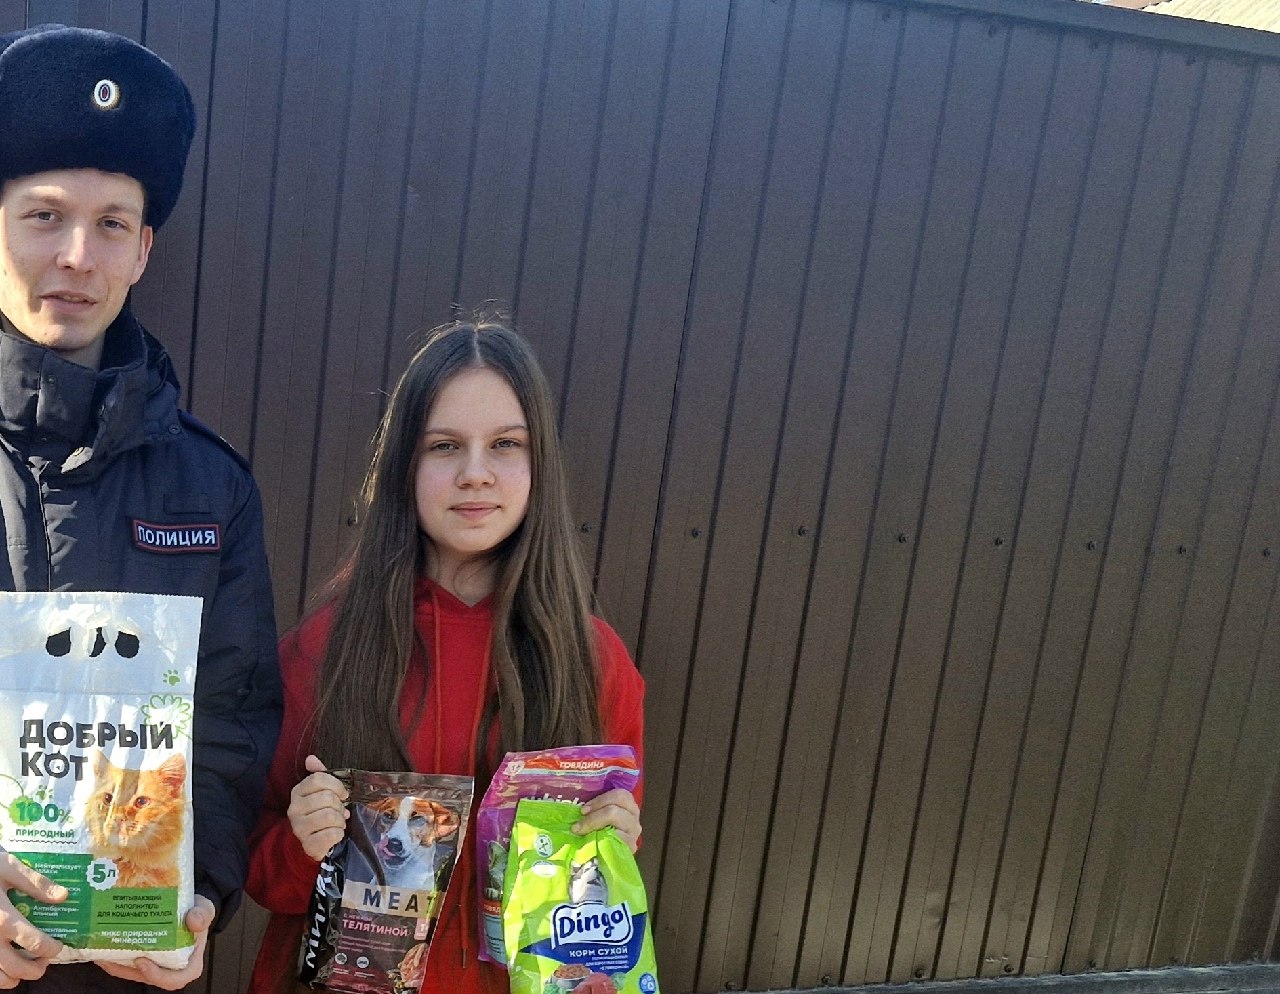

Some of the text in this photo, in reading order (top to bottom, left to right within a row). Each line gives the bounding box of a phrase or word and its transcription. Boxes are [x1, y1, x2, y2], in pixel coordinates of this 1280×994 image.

[137, 525, 216, 546] ПОЛИЦИЯ
[19, 719, 174, 749] ДОБРЫЙ
[21, 749, 89, 781] КОТ
[560, 761, 604, 769] ГОВЯДИНА
[16, 802, 74, 824] 100%
[15, 828, 75, 839] ПРИРОДНЫЙ
[342, 919, 408, 937] ТЕЛЯТИНОЙ
[558, 909, 624, 938] Dingo
[569, 950, 596, 958] КОРМ
[597, 946, 628, 956] СУХОЙ
